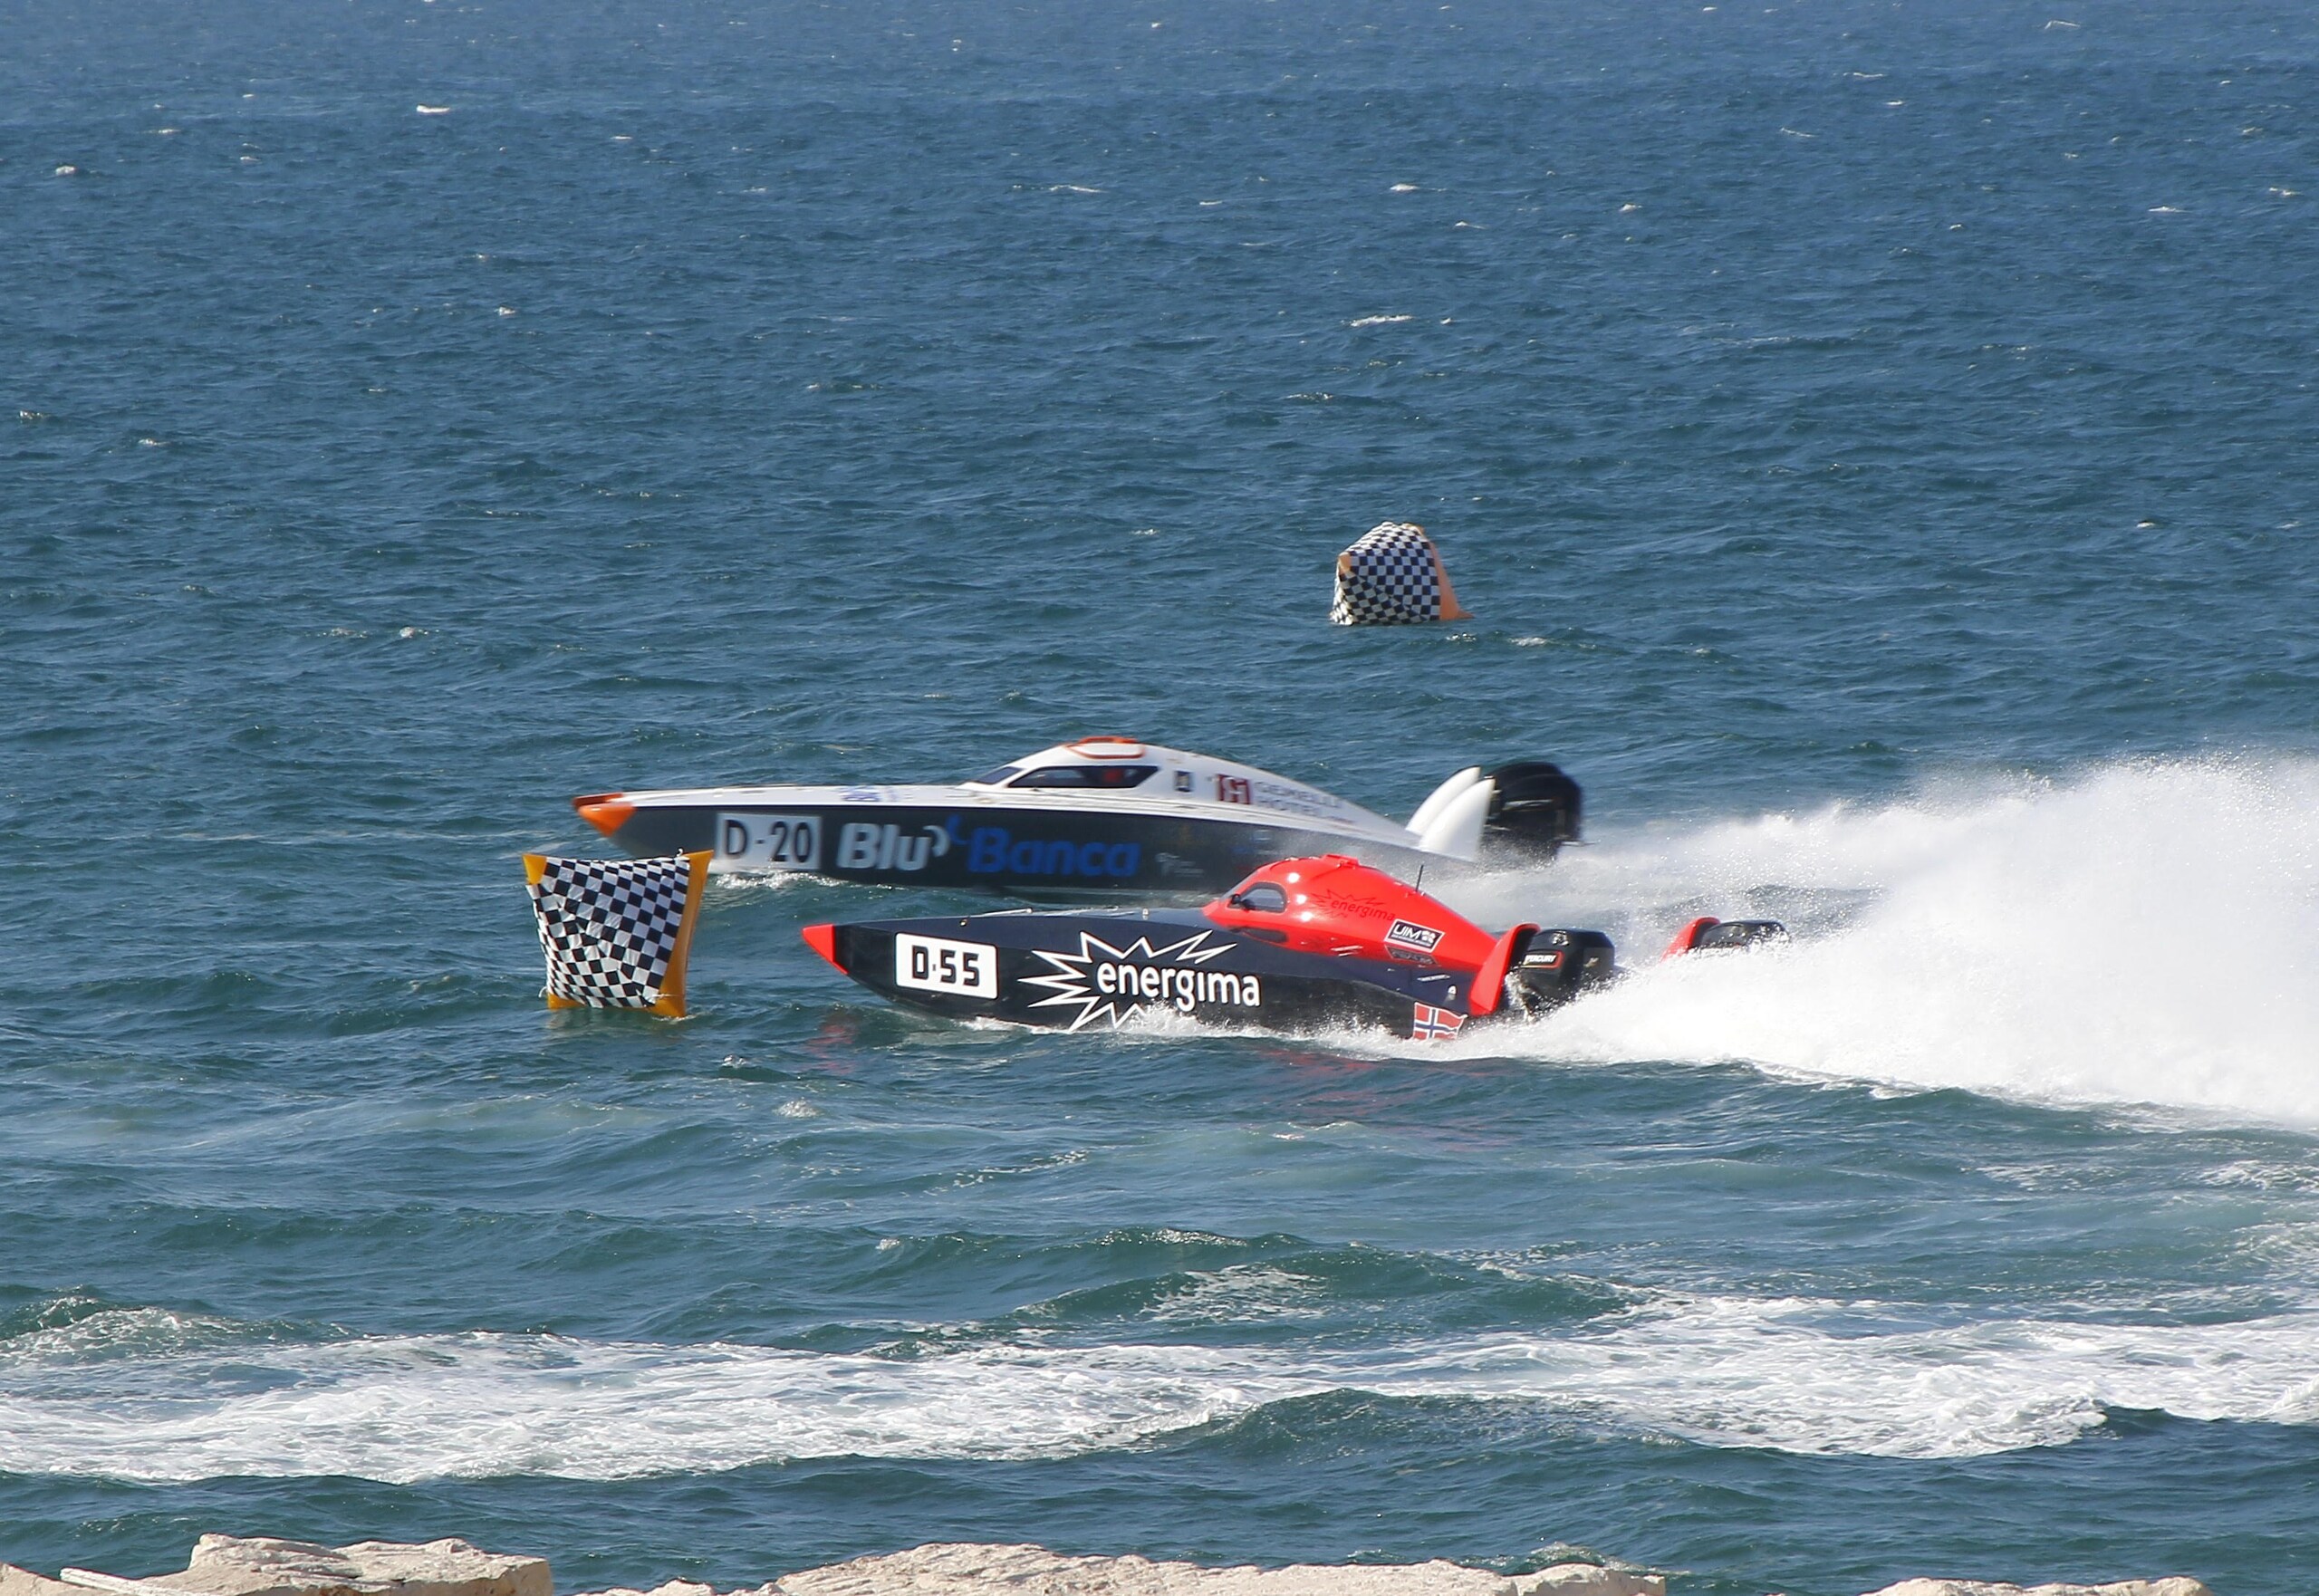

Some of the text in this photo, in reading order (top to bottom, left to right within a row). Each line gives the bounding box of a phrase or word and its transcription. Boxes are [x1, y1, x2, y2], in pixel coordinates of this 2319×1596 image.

[836, 822, 931, 871] Blu
[967, 826, 1140, 877] Banca
[1331, 899, 1396, 921] energima
[1393, 924, 1423, 940] UIM
[1096, 961, 1261, 1013] energima
